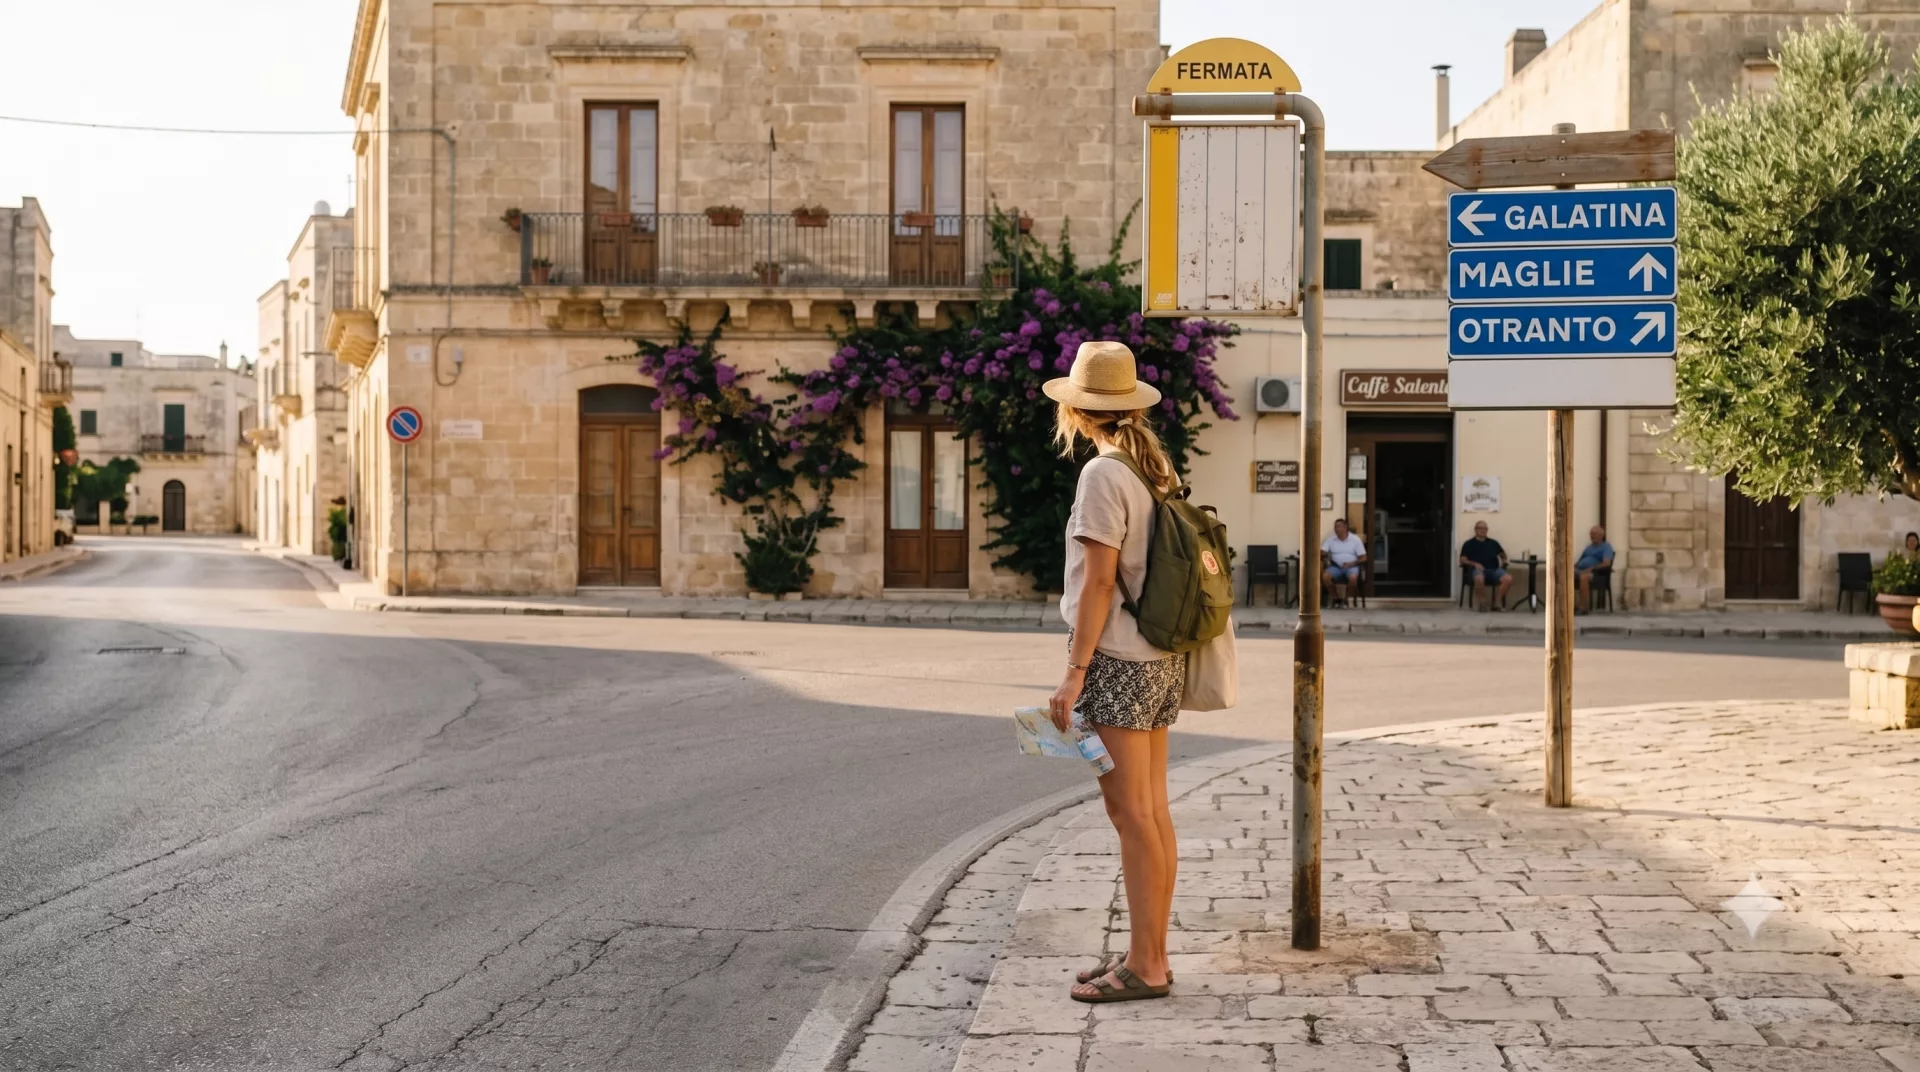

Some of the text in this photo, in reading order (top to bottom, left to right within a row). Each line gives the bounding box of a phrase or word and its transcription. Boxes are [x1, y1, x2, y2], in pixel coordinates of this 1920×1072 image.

[1177, 62, 1273, 80] FERMATA
[1504, 202, 1666, 230] GALATINA
[1459, 259, 1595, 288] MAGLIE
[1458, 316, 1616, 343] OTRANTO
[1347, 376, 1390, 399] Caffè
